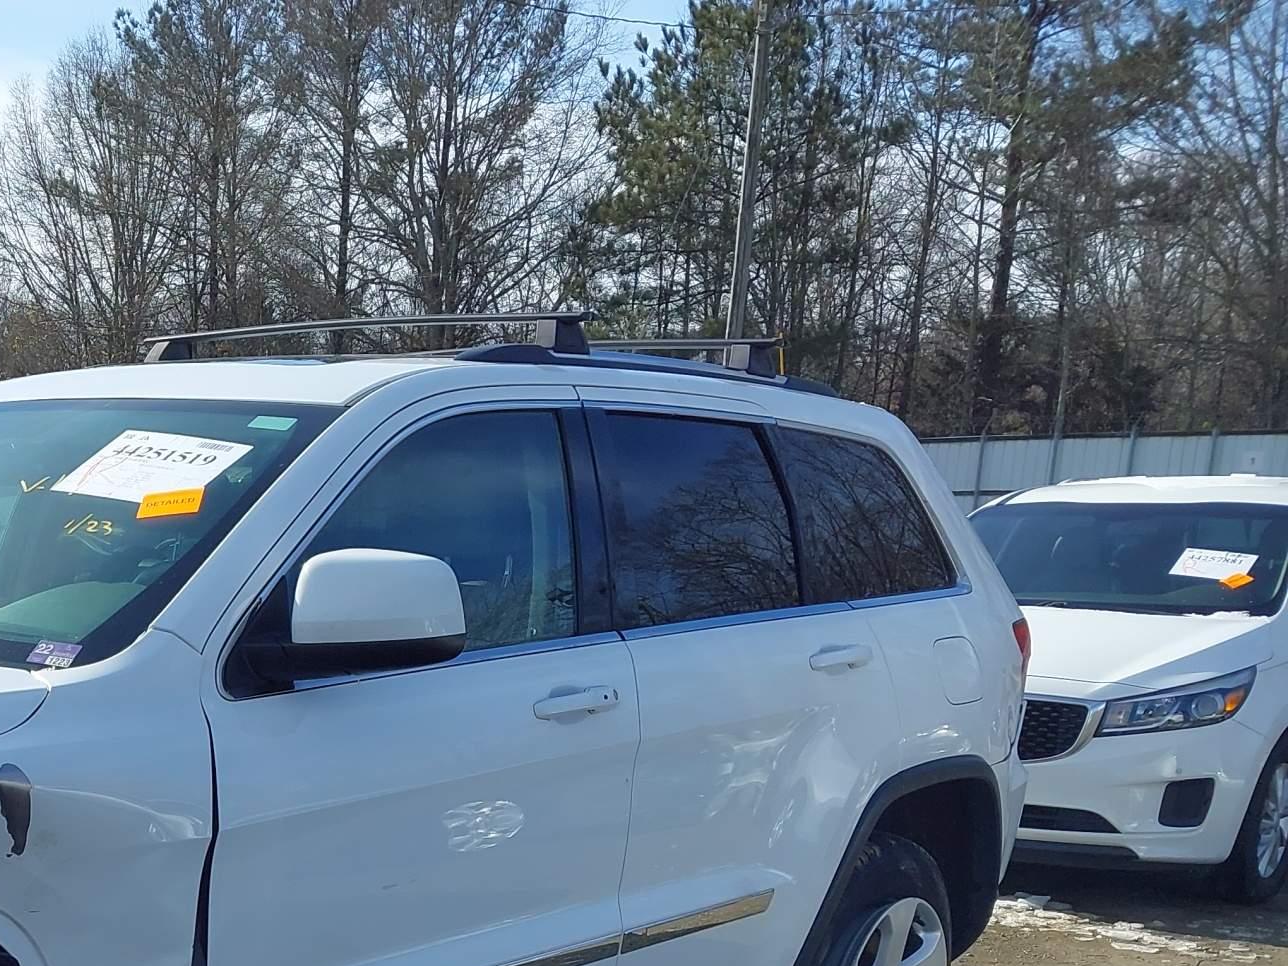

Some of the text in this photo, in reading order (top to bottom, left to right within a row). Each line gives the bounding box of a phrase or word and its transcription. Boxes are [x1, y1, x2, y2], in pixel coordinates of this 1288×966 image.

[112, 444, 217, 466] 44251519
[145, 497, 195, 508] DETAILED
[34, 643, 54, 655] 22
